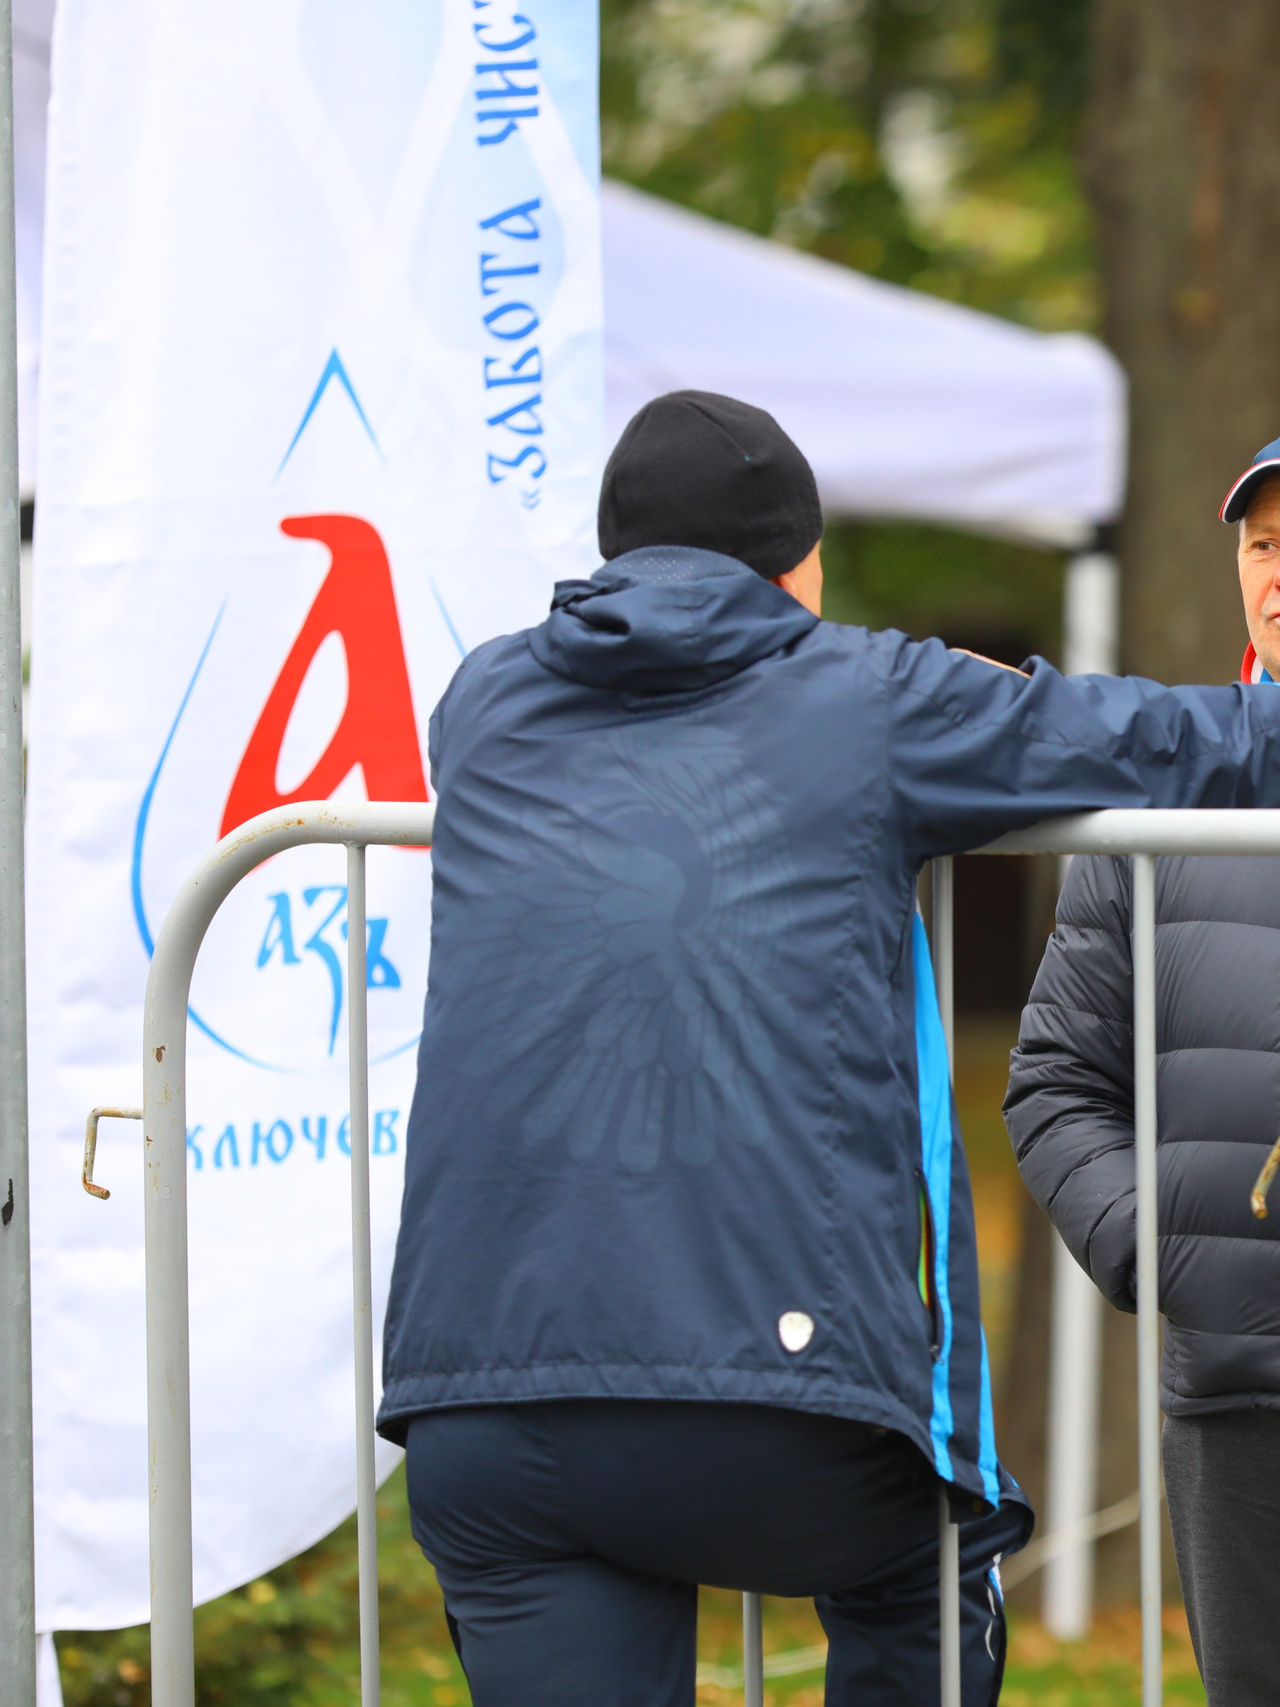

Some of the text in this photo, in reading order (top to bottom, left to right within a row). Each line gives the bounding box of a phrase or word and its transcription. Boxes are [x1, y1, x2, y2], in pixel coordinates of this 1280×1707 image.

[473, 0, 546, 511] «ЗАБОТА ЧИС
[185, 1110, 401, 1172] КЛЮЧЕВ
